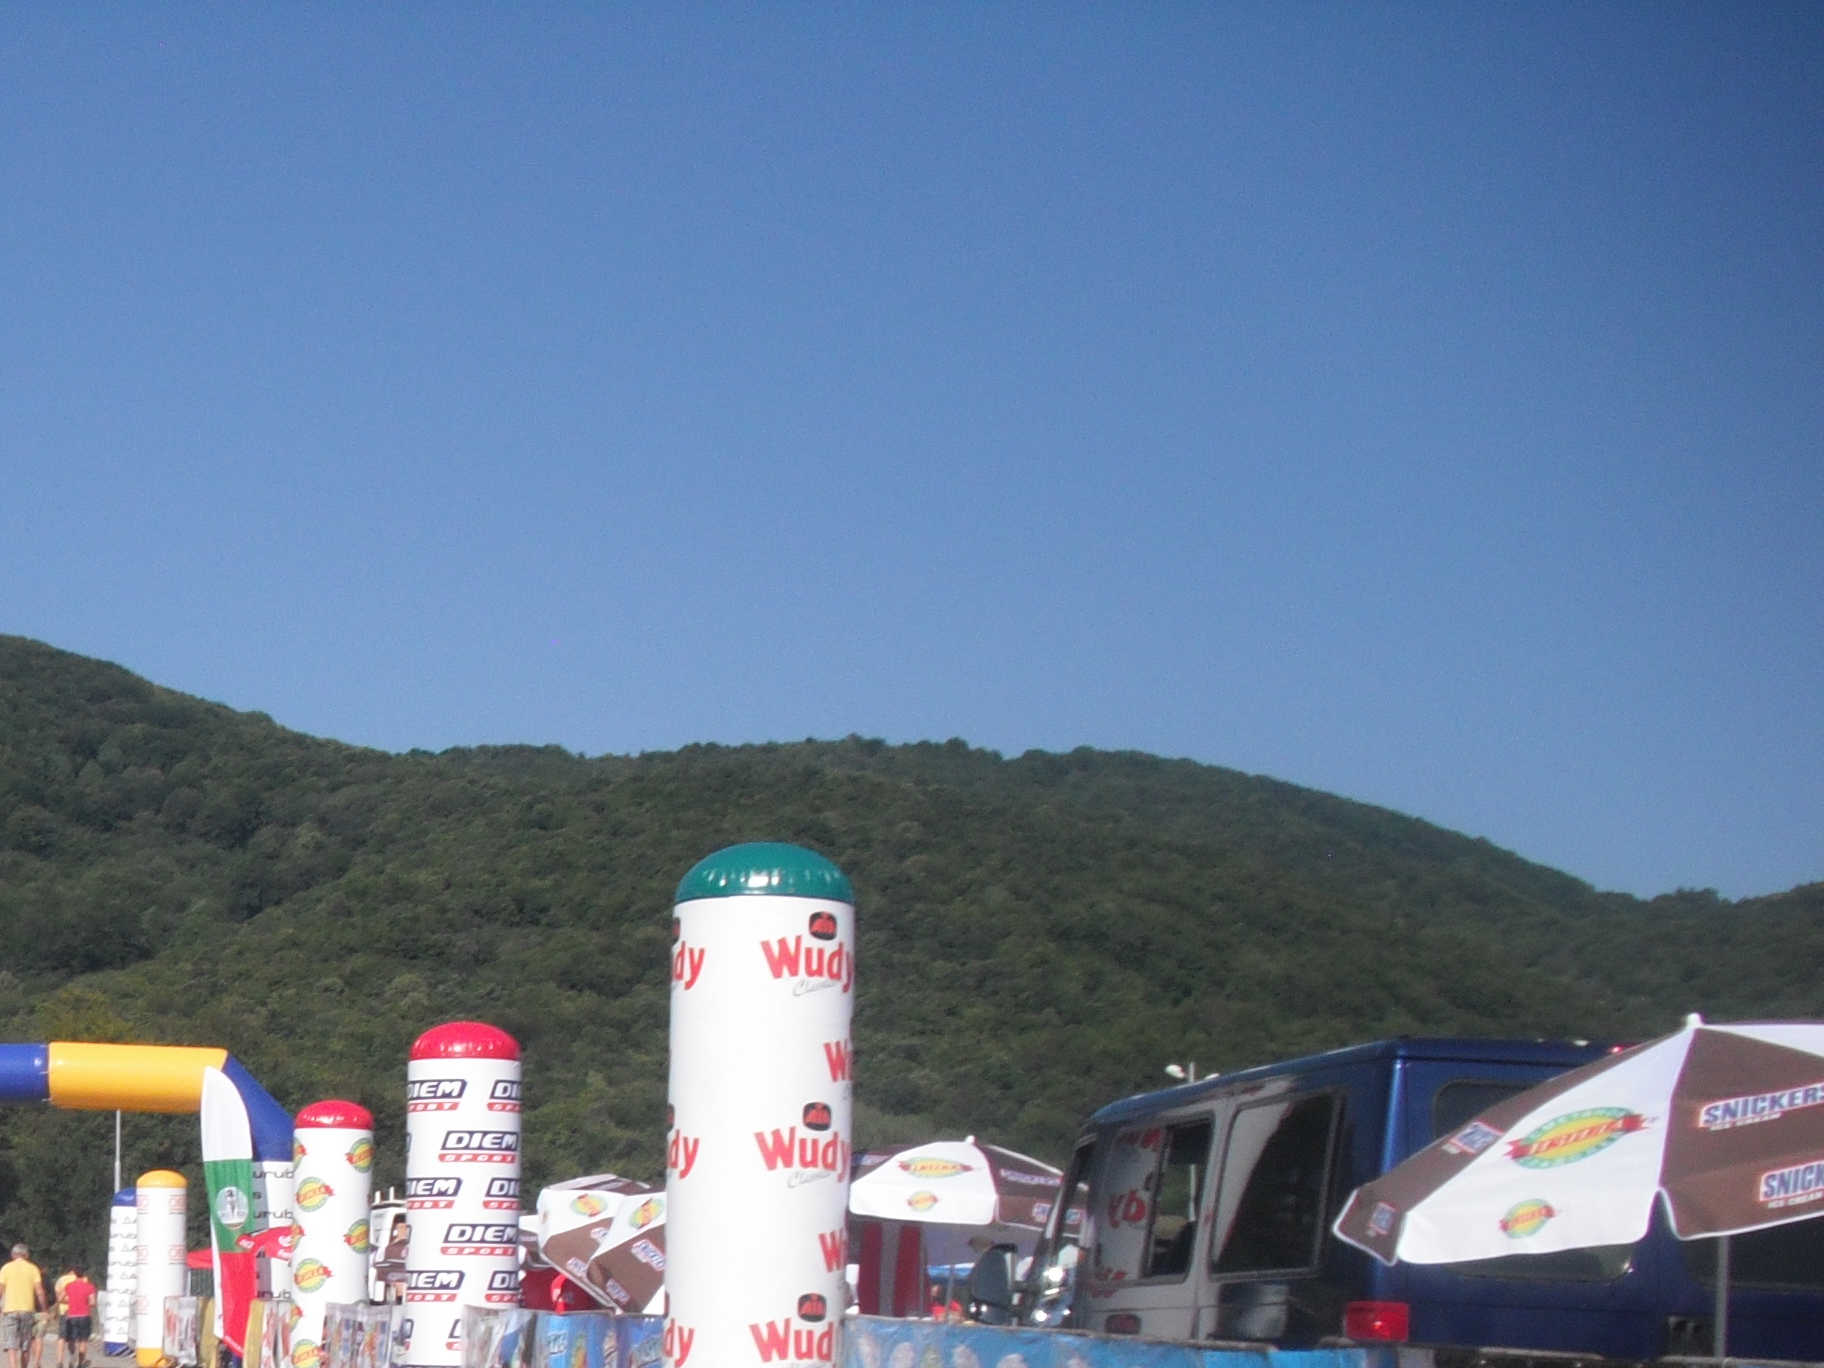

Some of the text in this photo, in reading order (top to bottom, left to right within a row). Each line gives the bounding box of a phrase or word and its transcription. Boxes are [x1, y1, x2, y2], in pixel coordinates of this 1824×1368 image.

[445, 1133, 516, 1149] DIEM
[447, 1225, 517, 1242] DIEM
[748, 1317, 838, 1364] Wud
